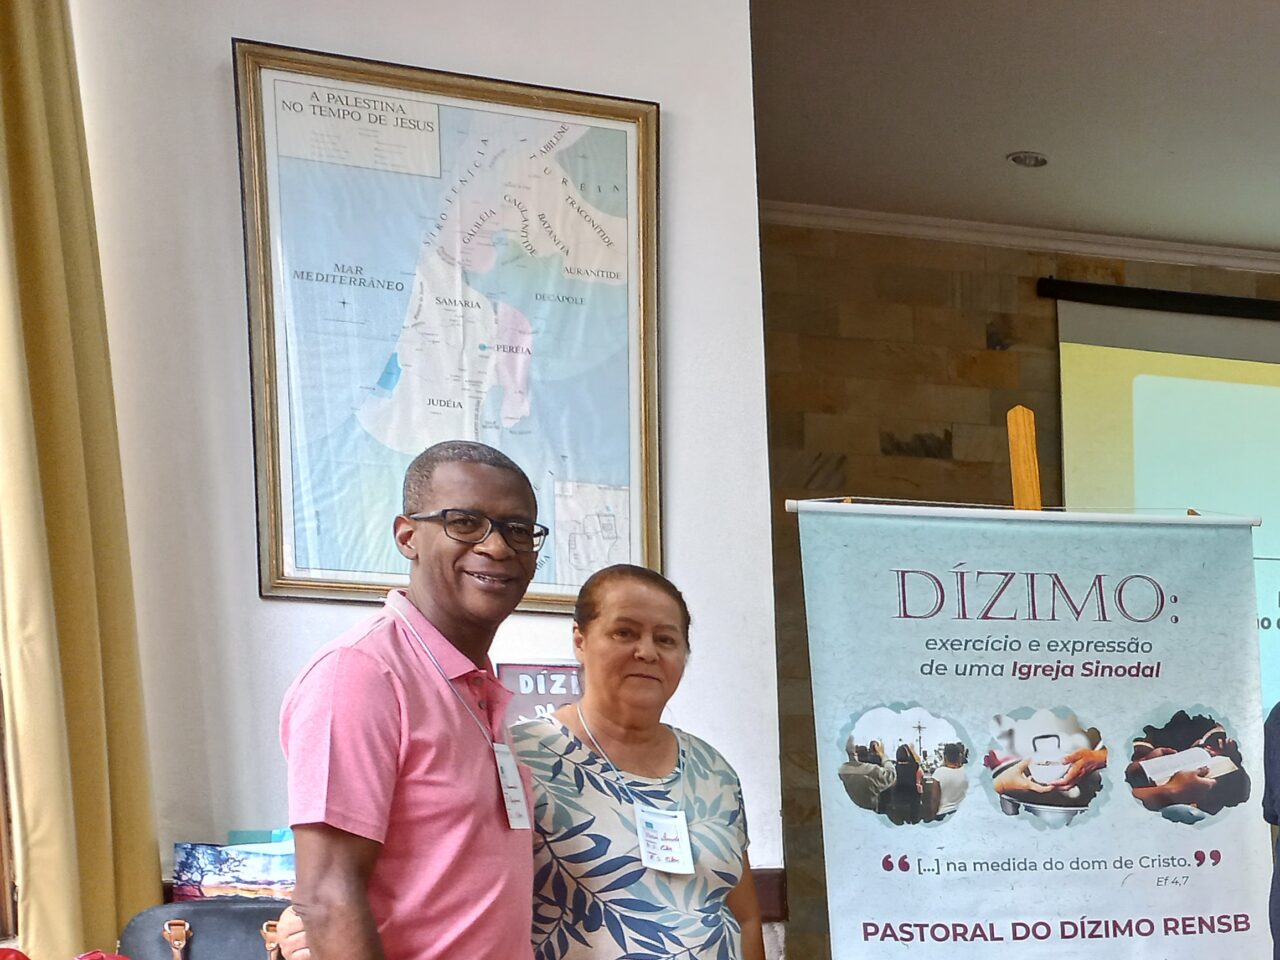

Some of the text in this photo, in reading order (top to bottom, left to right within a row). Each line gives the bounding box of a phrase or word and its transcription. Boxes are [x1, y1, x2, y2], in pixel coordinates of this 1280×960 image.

[310, 91, 406, 114] A PALESTINA
[282, 100, 434, 133] NO TEMPO DE JESUS
[539, 123, 569, 156] ABILENE
[334, 263, 364, 275] MAR
[293, 270, 405, 292] MEDITERRÂNEO
[435, 296, 482, 310] SAMARIA
[890, 562, 1179, 625] DÍZIMO:
[924, 634, 1153, 657] exercício e expressão
[920, 659, 1161, 681] de uma Igreja Sinodal
[946, 858, 968, 873] na
[972, 855, 1038, 873] medida
[1042, 854, 1066, 872] do
[1069, 855, 1108, 871] dom
[1112, 854, 1135, 870] de
[1138, 852, 1192, 870] Cristo.
[862, 913, 1252, 942] PASTORAL DO DÍZIMO RENSB
